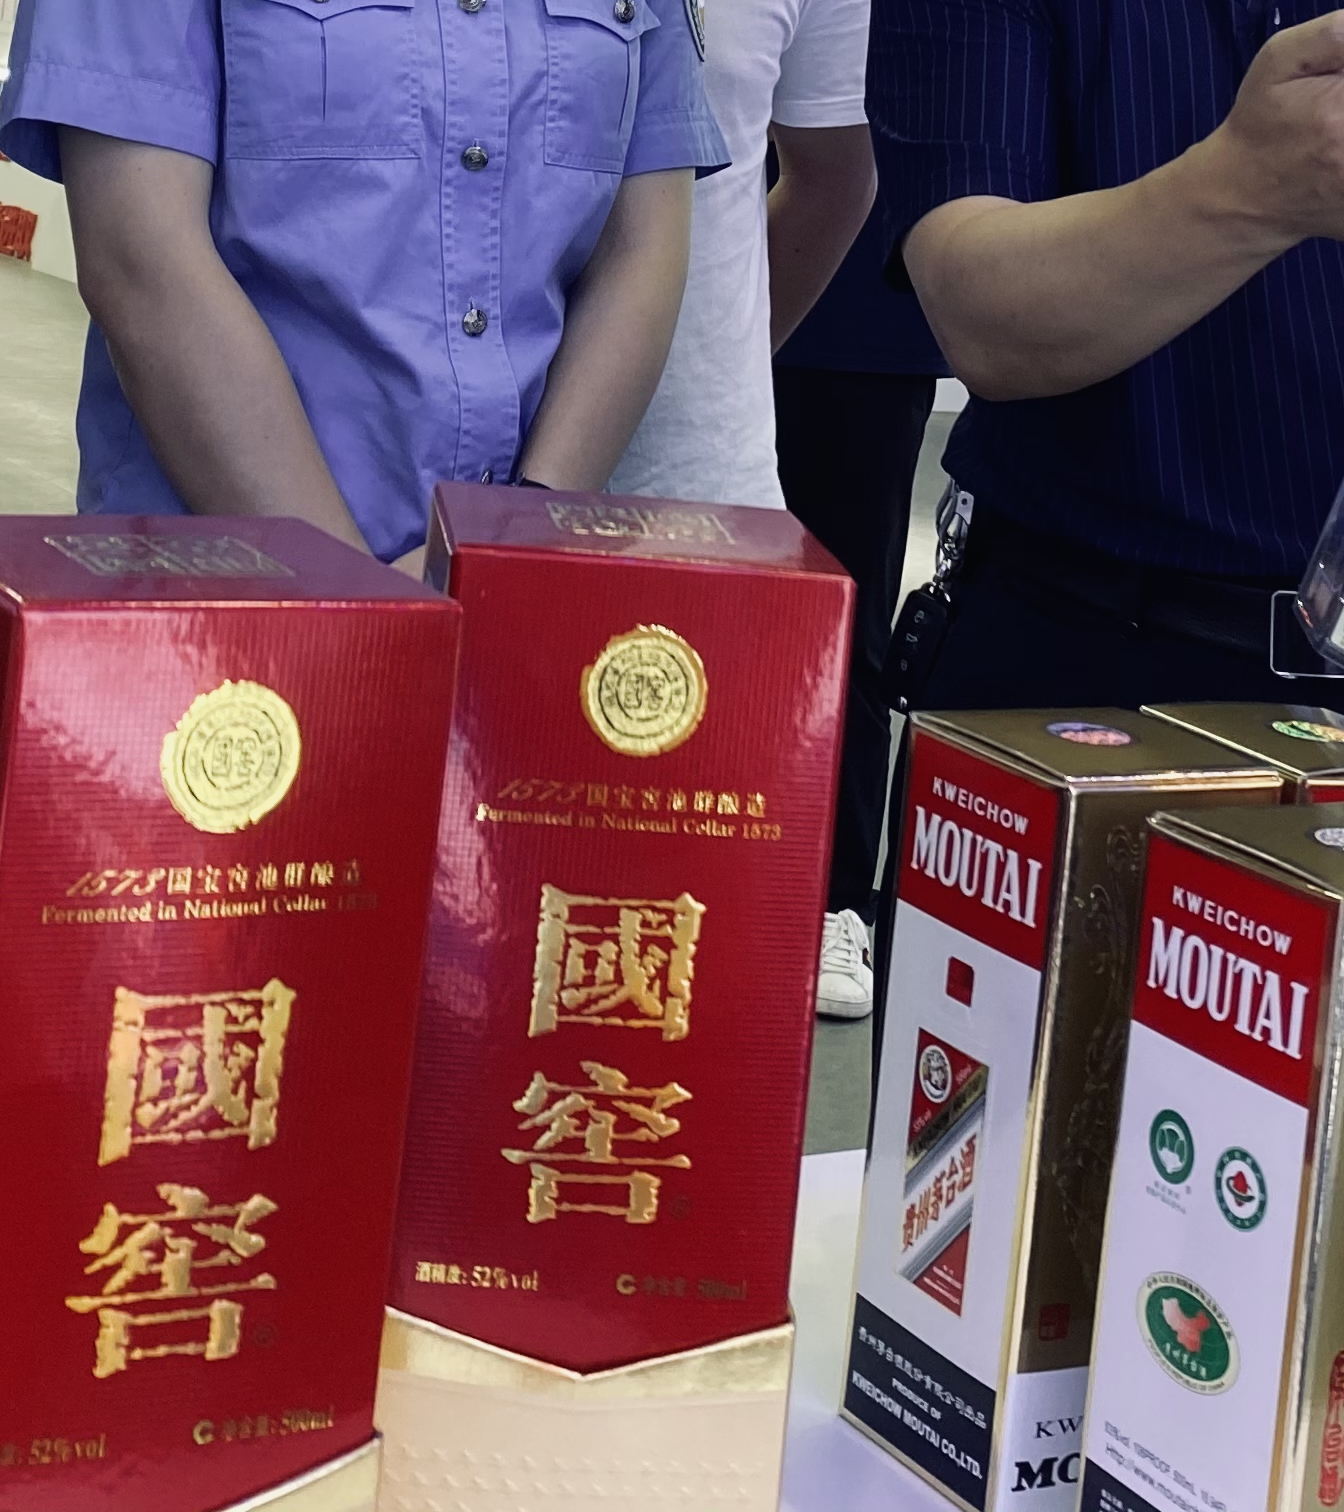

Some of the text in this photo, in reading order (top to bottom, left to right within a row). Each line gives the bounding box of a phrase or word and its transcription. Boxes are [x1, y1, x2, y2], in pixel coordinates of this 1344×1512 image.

[475, 802, 573, 828] Fermented
[579, 811, 596, 829] in
[601, 812, 678, 834] National
[932, 775, 1030, 836] KWEICHOW
[909, 805, 1044, 928] MOUTAI
[41, 900, 154, 925] Fermented
[158, 899, 178, 921] in
[184, 893, 267, 920] National
[1172, 884, 1293, 956] KWEICHOW
[1145, 916, 1310, 1061] MOUTAI
[852, 1369, 904, 1420] KWEICHOW
[902, 1408, 941, 1450] MOUTAI
